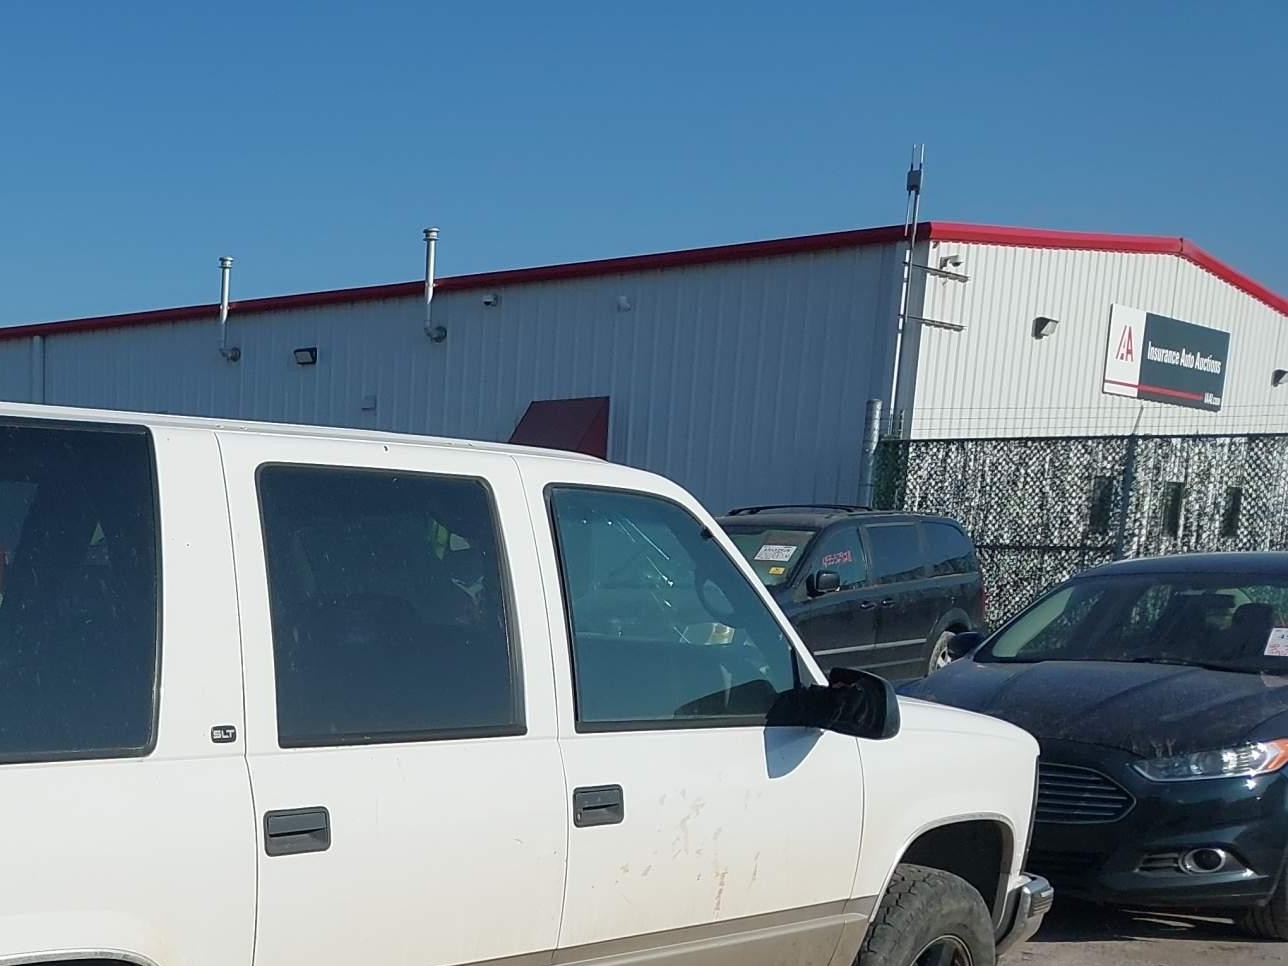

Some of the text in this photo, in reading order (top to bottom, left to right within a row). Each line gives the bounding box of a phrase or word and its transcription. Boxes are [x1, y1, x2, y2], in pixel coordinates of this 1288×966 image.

[1147, 341, 1221, 375] Insurance Auto Auctions
[213, 729, 234, 739] SLT
